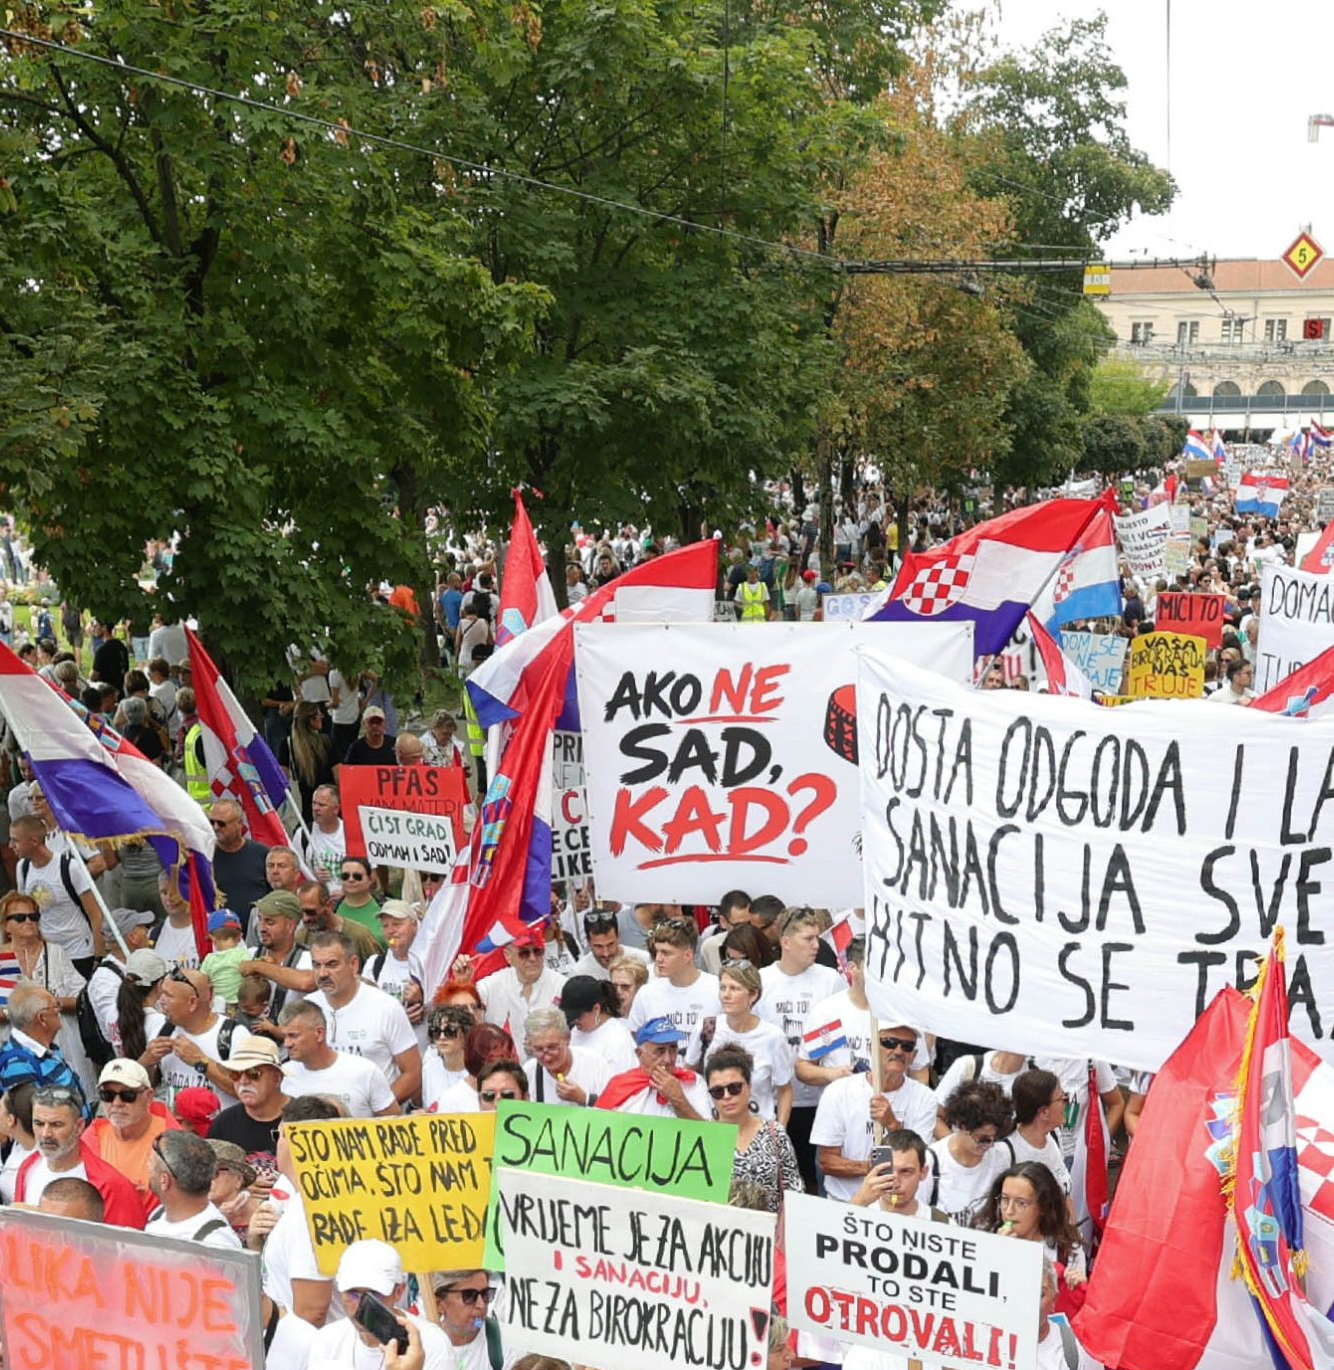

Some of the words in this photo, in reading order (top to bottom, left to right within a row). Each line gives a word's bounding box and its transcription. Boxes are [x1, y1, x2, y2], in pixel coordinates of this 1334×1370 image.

[1298, 248, 1307, 264] 5
[603, 670, 703, 723] AKO
[709, 663, 793, 718] NE
[1133, 675, 1198, 698] TRUJE
[377, 768, 439, 795] PFAS
[618, 722, 784, 790] SAD,
[875, 692, 973, 807] DOSTA
[995, 715, 1186, 838] ODGODA
[1225, 743, 1244, 842] I
[368, 810, 400, 834] ČIST
[406, 819, 447, 842] GRAD
[608, 771, 838, 860] KAD?
[368, 840, 410, 861] ODMAH
[882, 797, 1145, 935] SANACIJA
[866, 893, 1020, 1014] HITNO
[1058, 941, 1135, 1030] SE
[286, 1126, 330, 1163] ŠTO
[332, 1124, 376, 1159] NAM
[376, 1123, 426, 1157] RADE
[429, 1119, 477, 1155] PRED
[500, 1113, 714, 1187] SANACIJA
[375, 1162, 422, 1197] ŠTO
[431, 1156, 478, 1192] NAM
[382, 1206, 425, 1243] IZA
[498, 1189, 612, 1258] VRIJEME
[701, 1218, 773, 1288] AKCIJU
[842, 1215, 894, 1243] ŠTO
[901, 1227, 977, 1262] NISTE
[553, 1251, 563, 1271] I
[815, 1232, 1008, 1304] PRODALI,
[123, 1258, 237, 1334] NIJE
[508, 1280, 541, 1325] NE
[542, 1282, 581, 1341] ZA
[866, 1274, 901, 1300] TO
[907, 1284, 956, 1312] STE
[803, 1284, 1018, 1370] OTROVALI!
